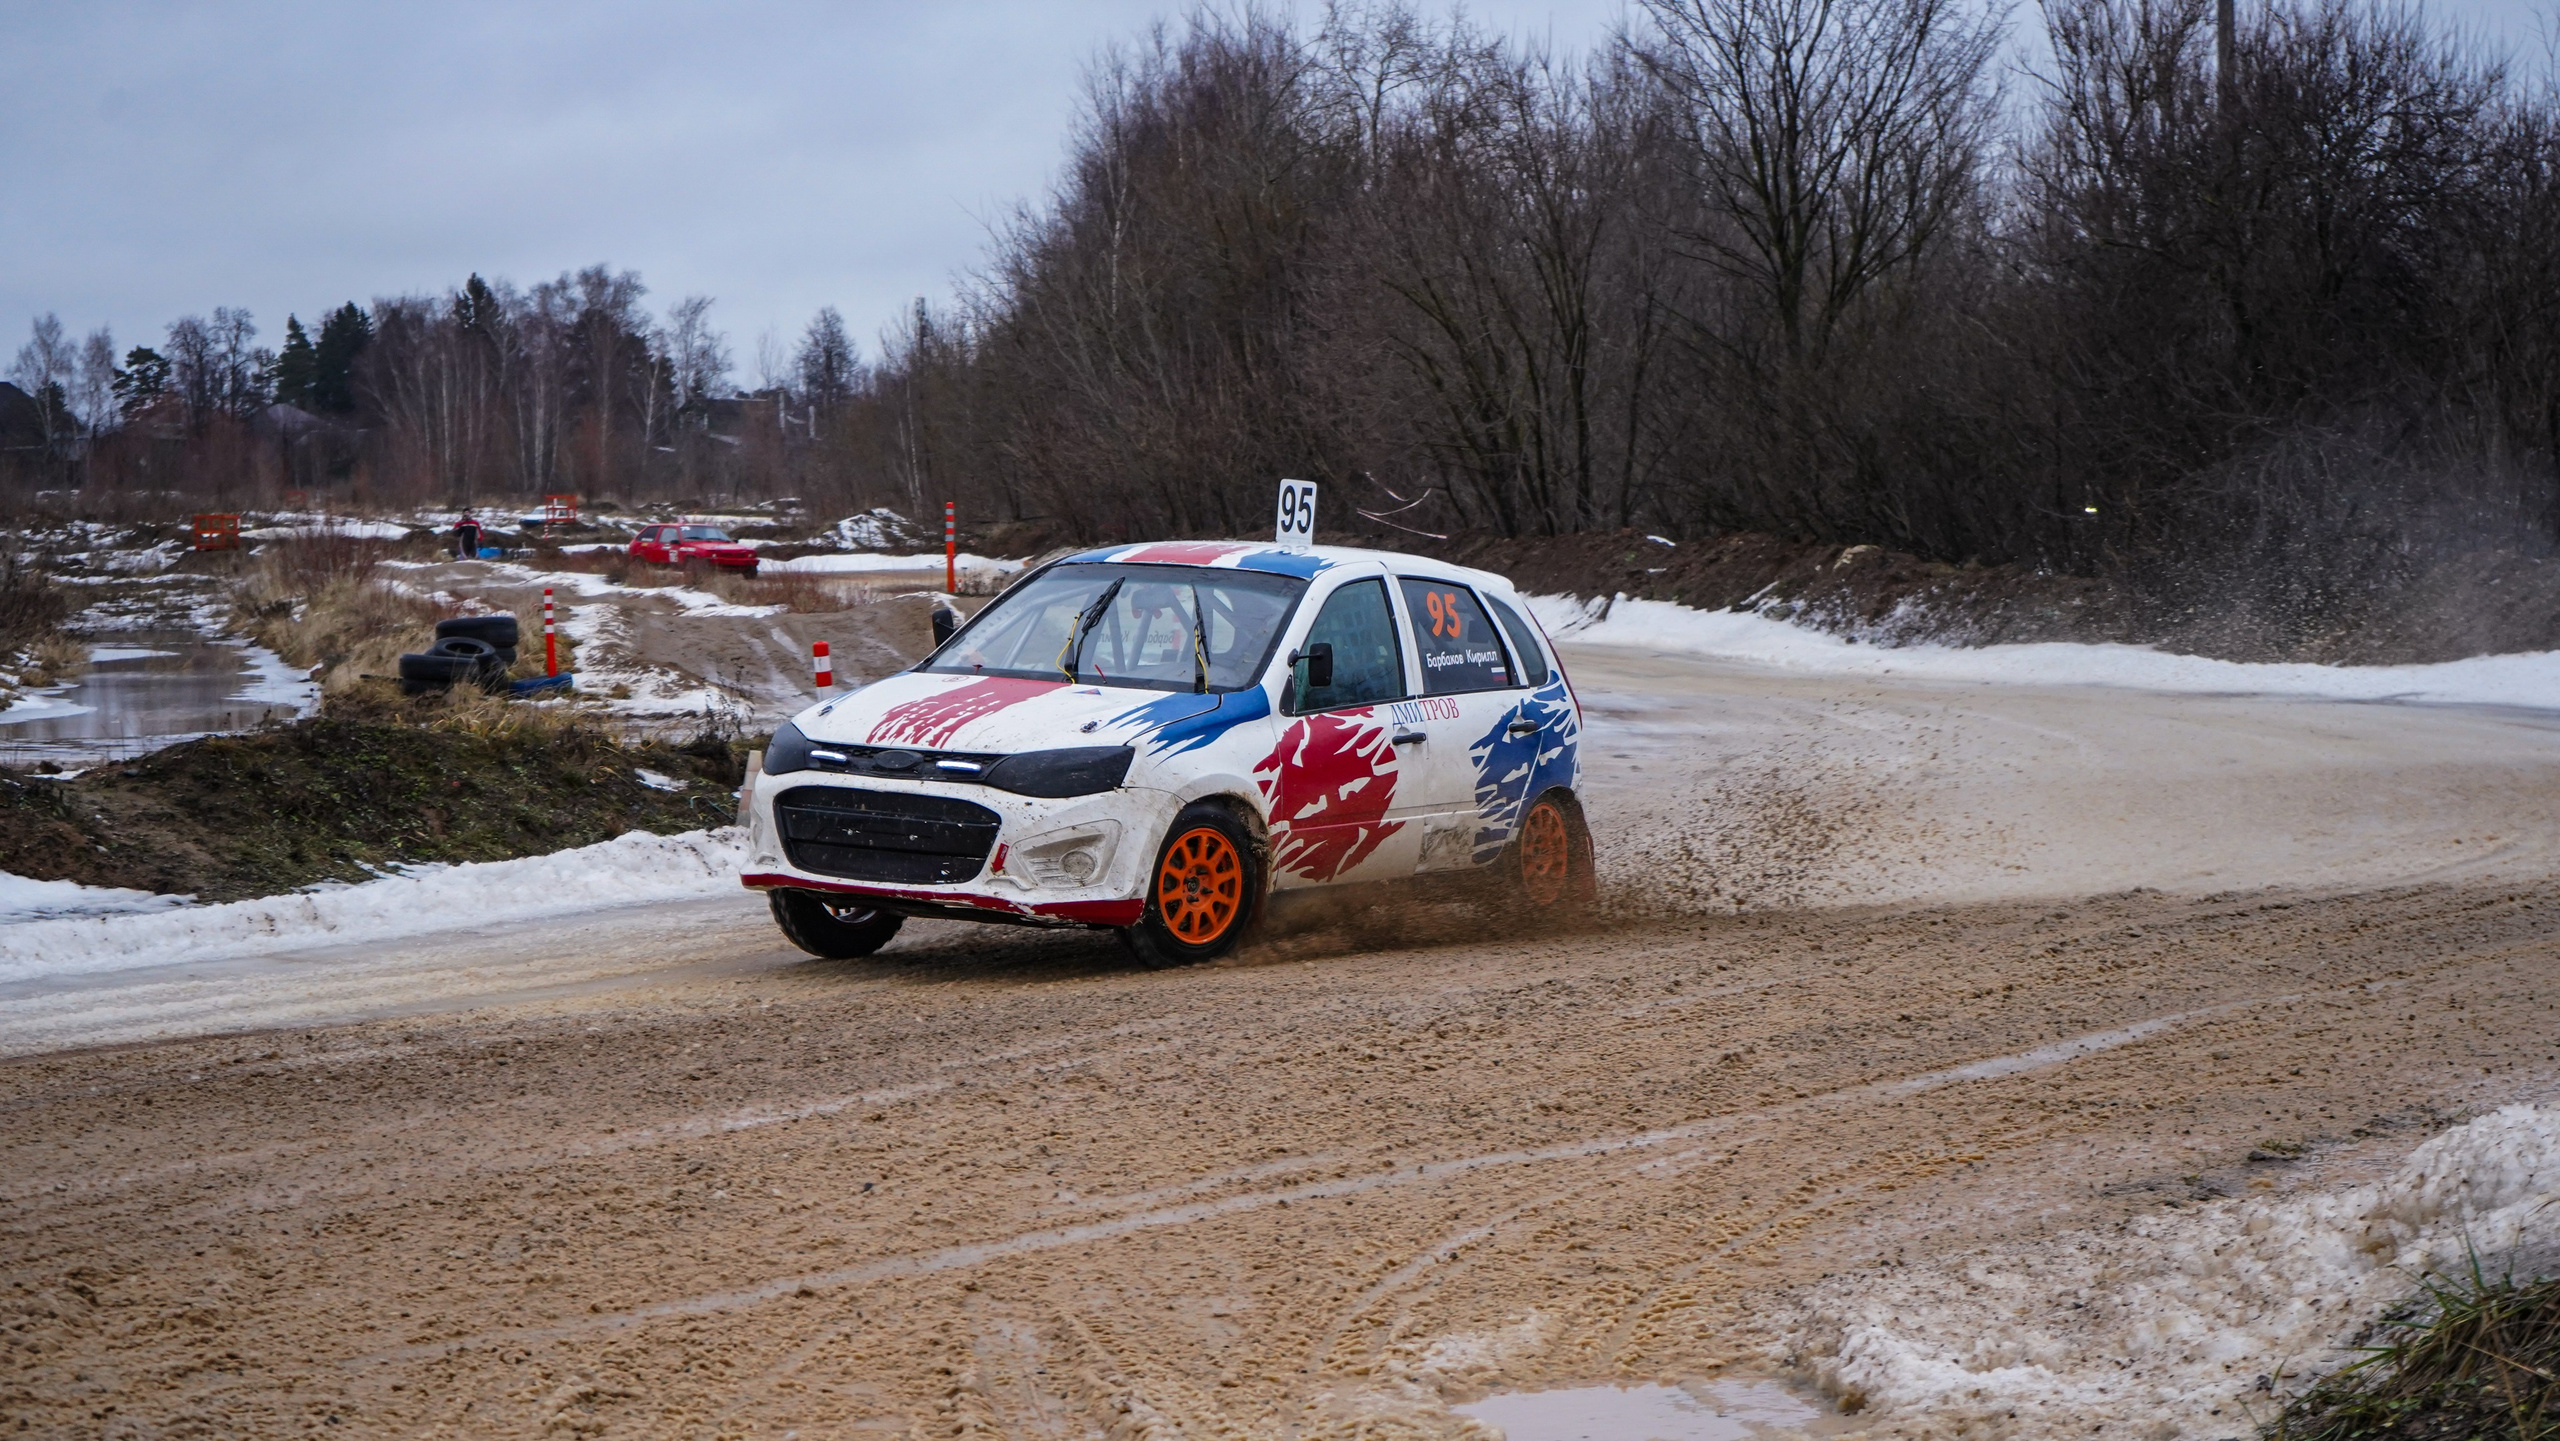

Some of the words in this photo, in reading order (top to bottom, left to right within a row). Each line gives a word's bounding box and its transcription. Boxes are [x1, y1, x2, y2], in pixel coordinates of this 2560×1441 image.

[1281, 485, 1313, 534] 95
[1426, 591, 1461, 638] 95
[1426, 651, 1464, 671] Барбаков
[1465, 649, 1498, 667] Кирилл
[1390, 698, 1460, 731] ДМИТРОВ
